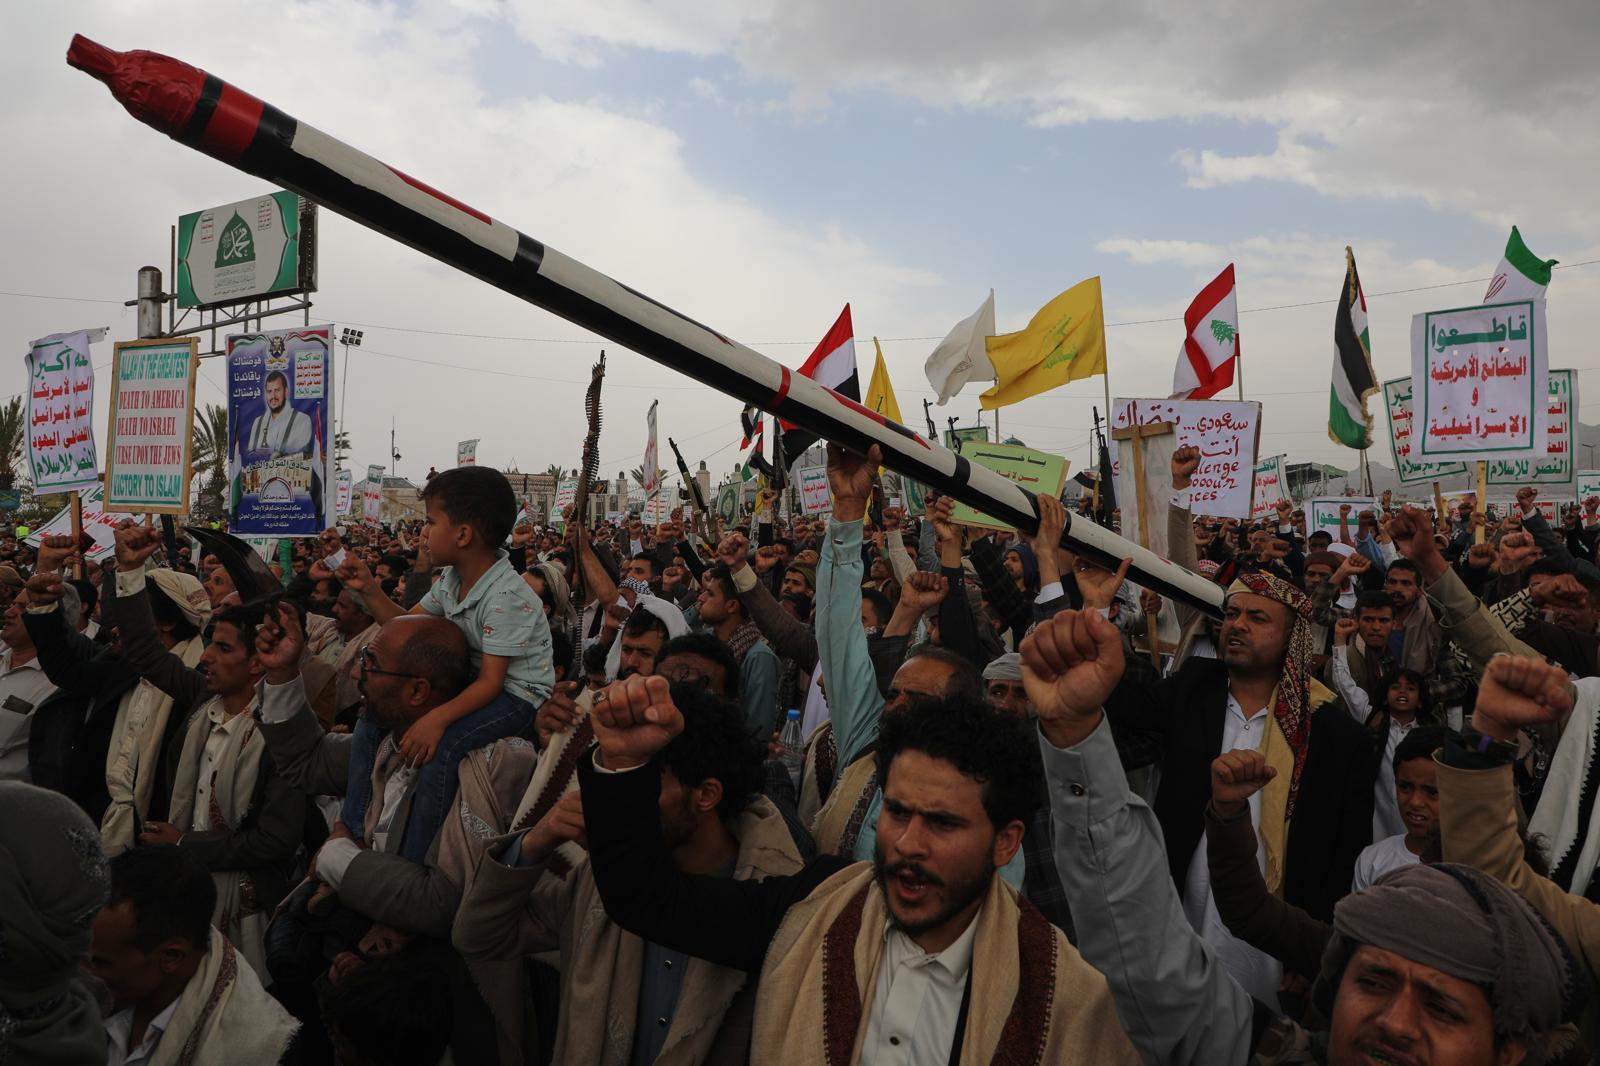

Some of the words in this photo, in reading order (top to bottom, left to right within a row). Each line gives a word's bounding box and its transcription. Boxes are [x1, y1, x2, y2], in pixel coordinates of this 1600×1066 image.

[1430, 314, 1526, 352] قاطعوا
[157, 352, 190, 379] GREATEST
[233, 356, 262, 367] فوضناك
[1430, 353, 1478, 385] الأمريكية
[1480, 355, 1526, 381] البضائع
[119, 391, 140, 410] DEATH
[141, 390, 151, 409] TO
[151, 390, 185, 409] AMERICA
[233, 387, 261, 398] فوضناك
[1471, 387, 1478, 406] و
[117, 417, 138, 436] DEATH
[139, 417, 149, 436] TO
[149, 417, 176, 436] ISRAEL
[1429, 414, 1526, 441] الإسرائيلية
[32, 430, 60, 451] اليهود
[1201, 434, 1239, 457] أنت
[73, 447, 97, 477] النصر
[115, 445, 132, 465] CURSE
[132, 445, 150, 465] UPON
[150, 445, 163, 465] THE
[163, 445, 182, 465] JEWS
[36, 453, 73, 480] للإسلام
[1490, 459, 1529, 480] للإسلام
[1532, 457, 1567, 479] النصر
[113, 474, 143, 497] VICTORY
[144, 474, 154, 497] TO
[155, 474, 181, 498] ISLAM
